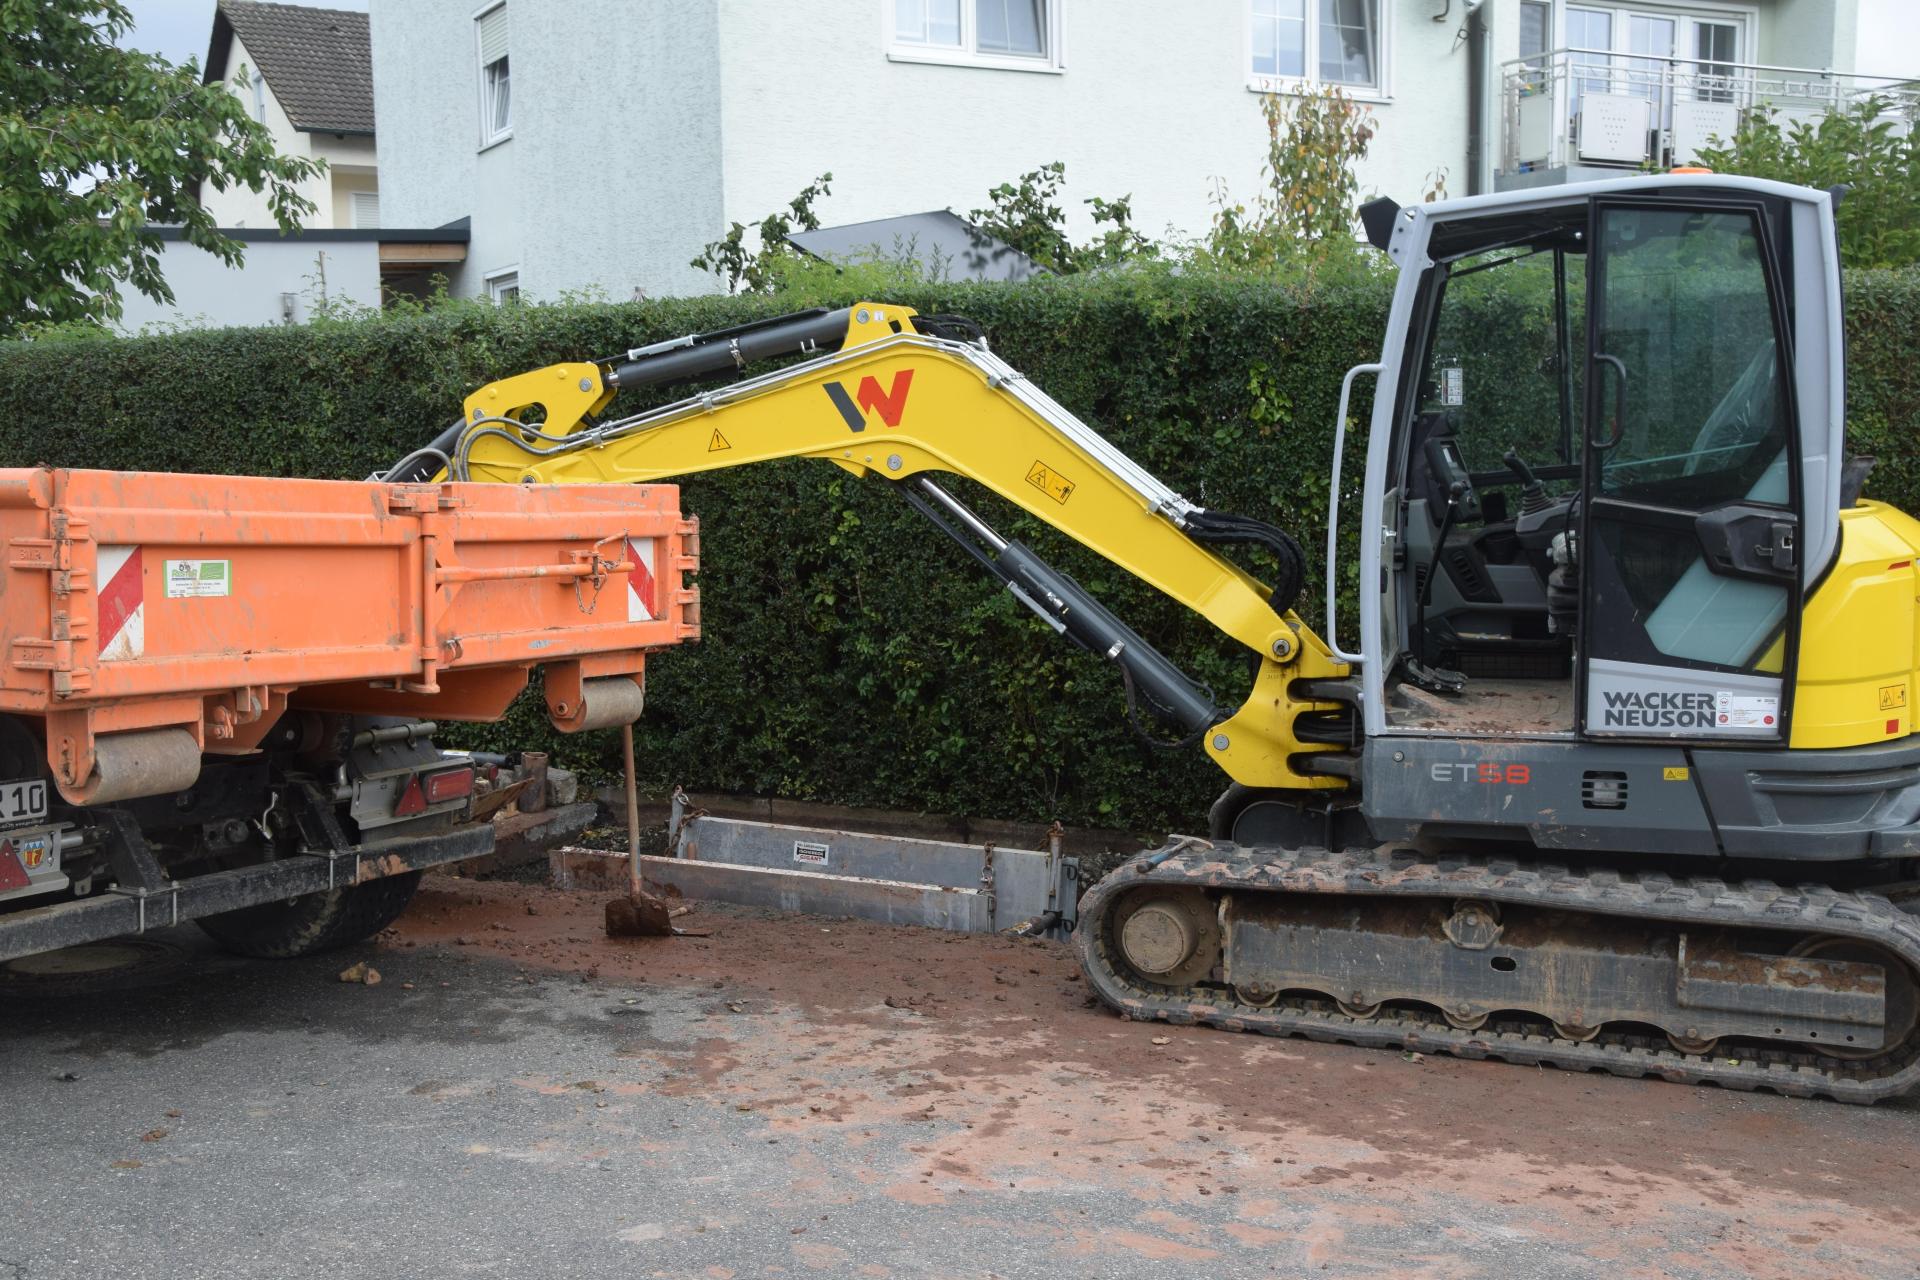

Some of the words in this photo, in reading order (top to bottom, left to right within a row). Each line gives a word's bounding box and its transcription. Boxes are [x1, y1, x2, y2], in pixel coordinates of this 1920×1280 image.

[1603, 692, 1716, 710] WACKER
[1604, 709, 1716, 728] NEUSON
[1431, 763, 1530, 784] ET58
[12, 784, 44, 817] 10
